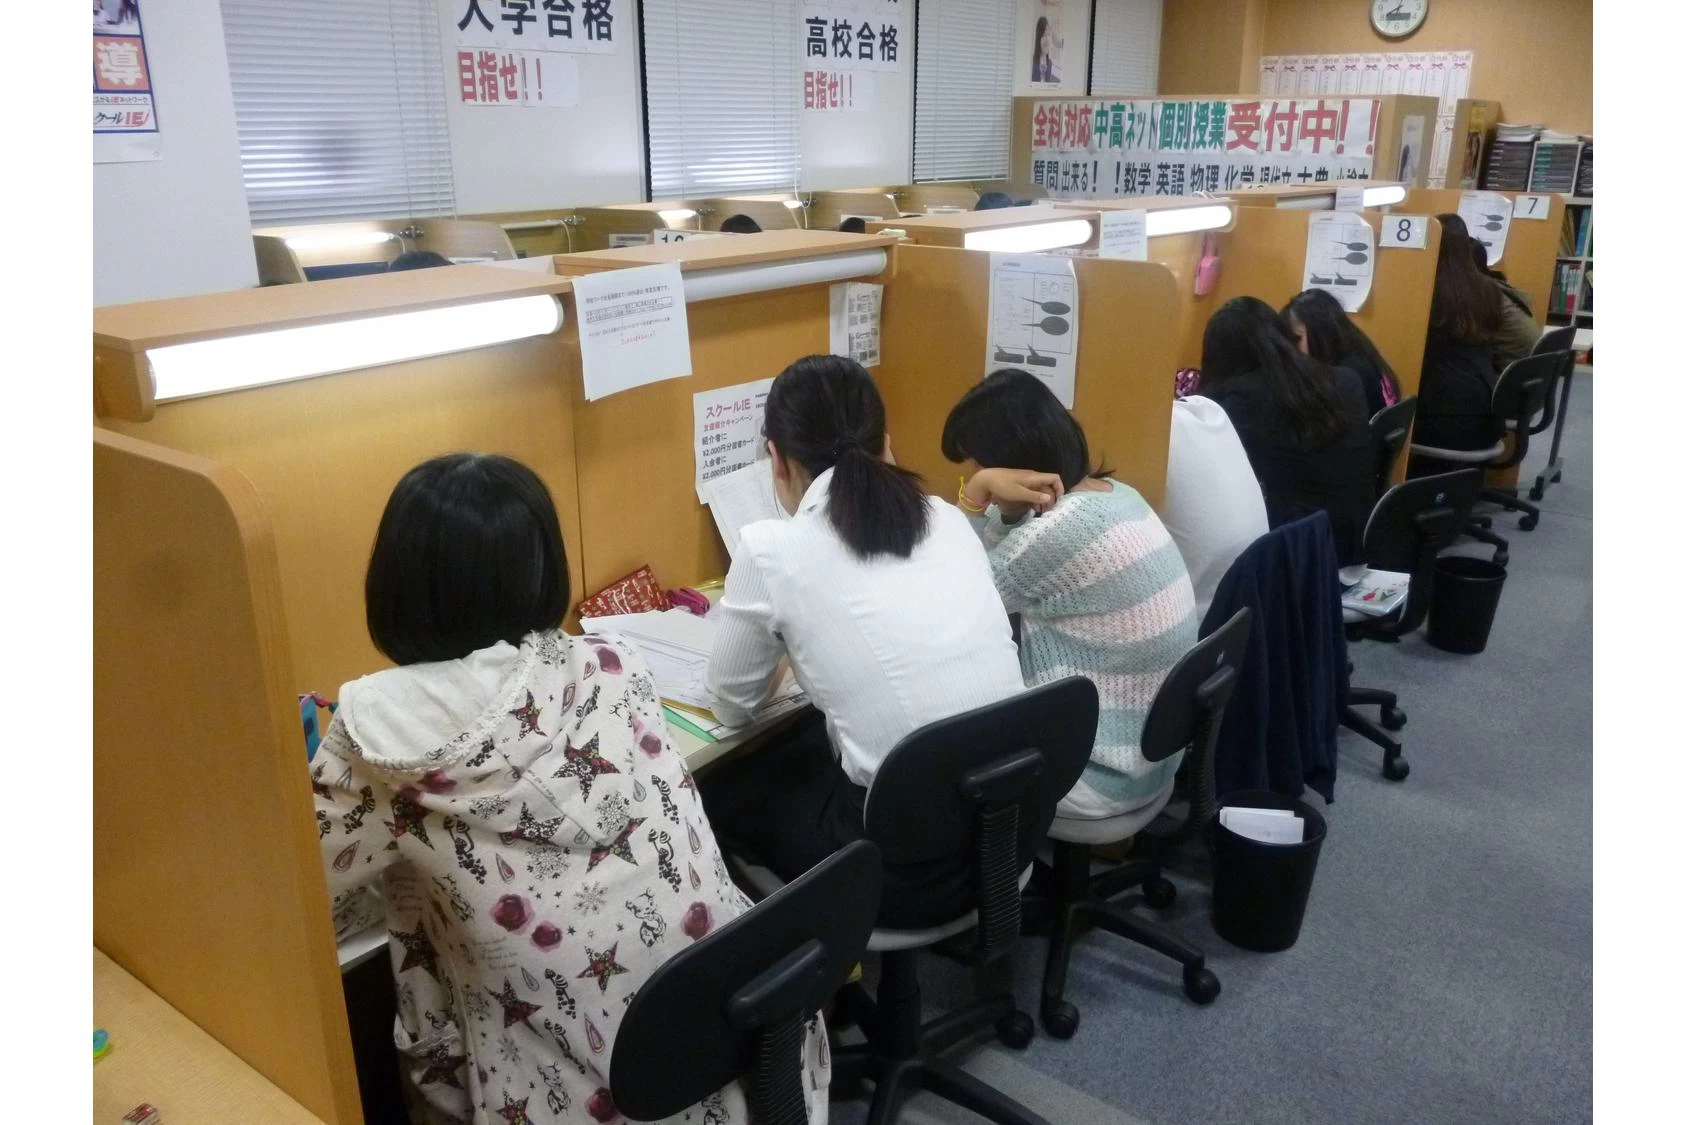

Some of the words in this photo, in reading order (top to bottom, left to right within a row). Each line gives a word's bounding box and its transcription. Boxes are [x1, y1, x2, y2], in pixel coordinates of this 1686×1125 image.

[805, 16, 899, 62] 高校合格
[1156, 162, 1186, 195] 英語
[1527, 197, 1538, 215] 7
[1396, 219, 1411, 242] 8
[706, 398, 751, 418] スクールIE
[702, 433, 728, 445] 紹介者に
